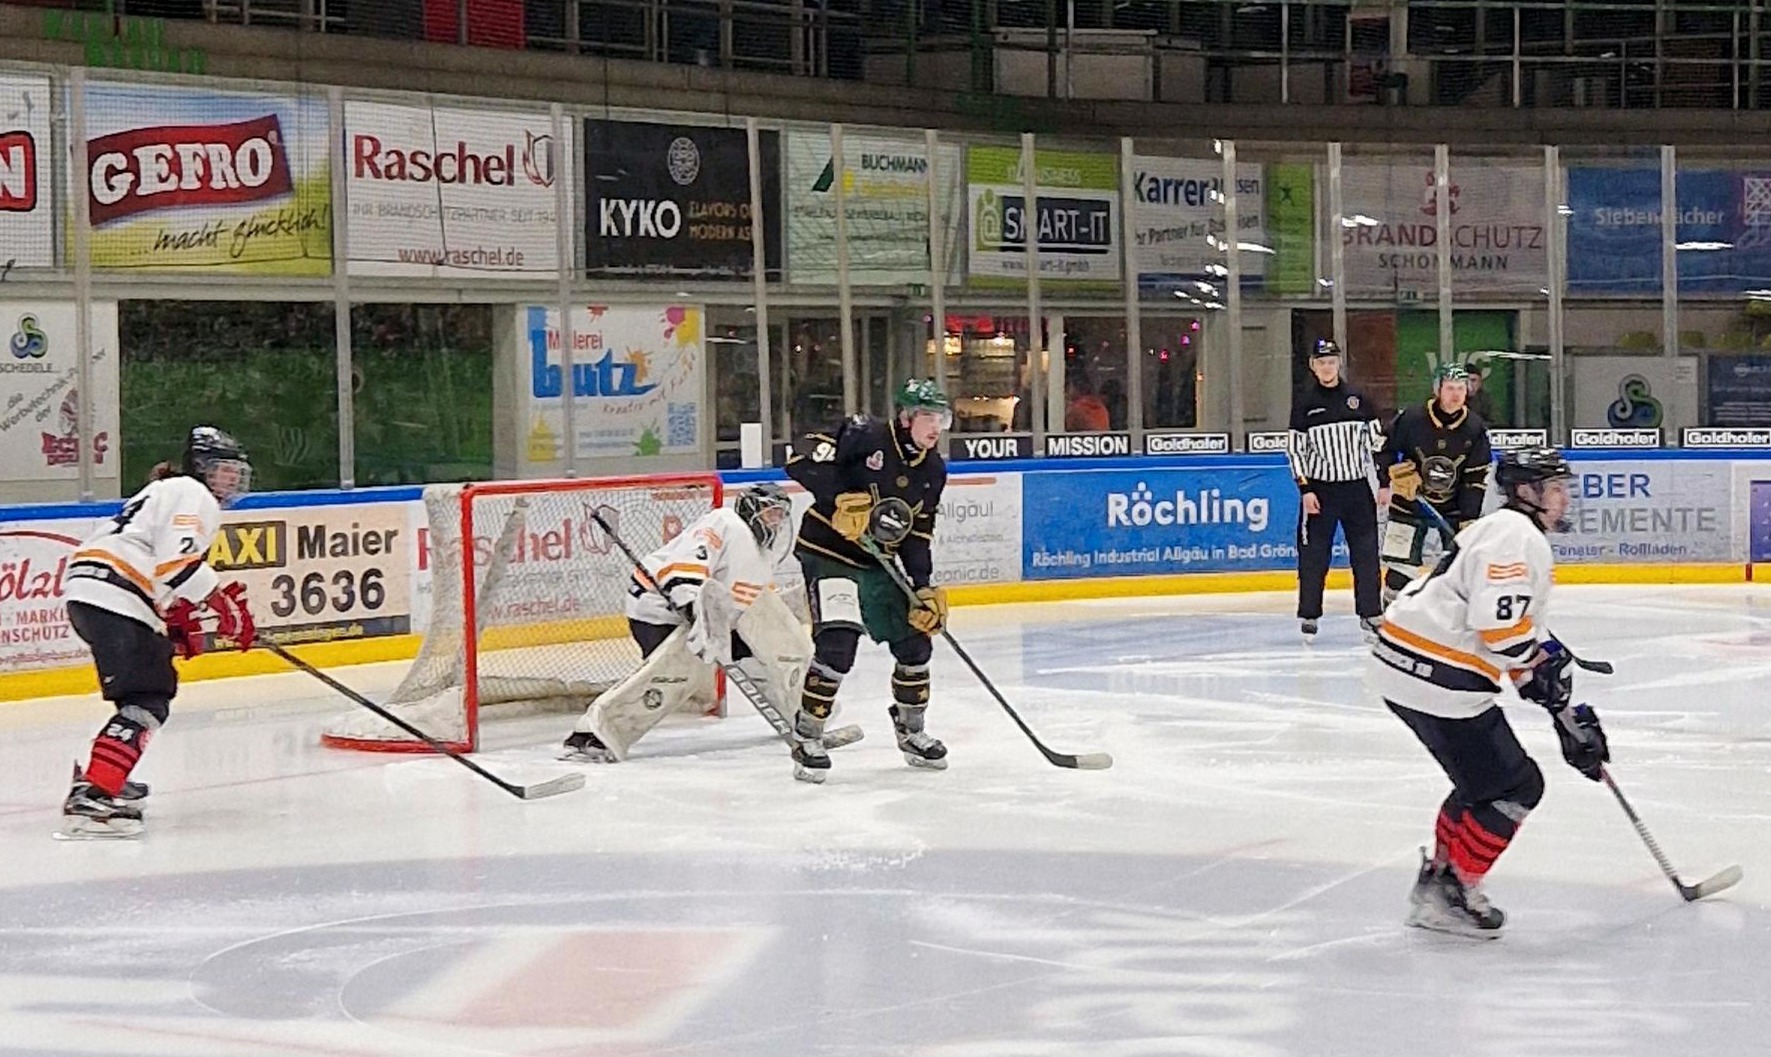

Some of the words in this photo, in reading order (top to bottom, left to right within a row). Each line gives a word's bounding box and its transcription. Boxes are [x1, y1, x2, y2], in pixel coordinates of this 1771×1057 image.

[353, 134, 515, 187] Raschel
[861, 153, 928, 174] BUCHMAN
[1134, 171, 1207, 207] Karrer
[600, 198, 682, 239] KYKO
[1343, 223, 1543, 249] RANDCHUTZ
[548, 329, 604, 350] Mlerei
[532, 329, 658, 398] butz
[965, 438, 1019, 458] YOUR
[1048, 435, 1129, 456] MISSION
[1151, 437, 1226, 451] Goldhofer
[1490, 432, 1543, 446] dhofer
[1575, 432, 1657, 446] Goldhofer
[1687, 431, 1770, 446] Goldhofer
[1569, 474, 1652, 499] EBER
[1107, 481, 1269, 532] Röchling
[207, 526, 277, 567] AXI
[297, 523, 399, 560] Maier
[1032, 549, 1091, 568] Röchling
[1095, 548, 1160, 564] Industrial
[1163, 546, 1208, 564] Allgäu
[1212, 546, 1225, 559] in
[1228, 544, 1257, 557] Bad
[270, 567, 386, 618] 3636
[1496, 594, 1532, 620] 87
